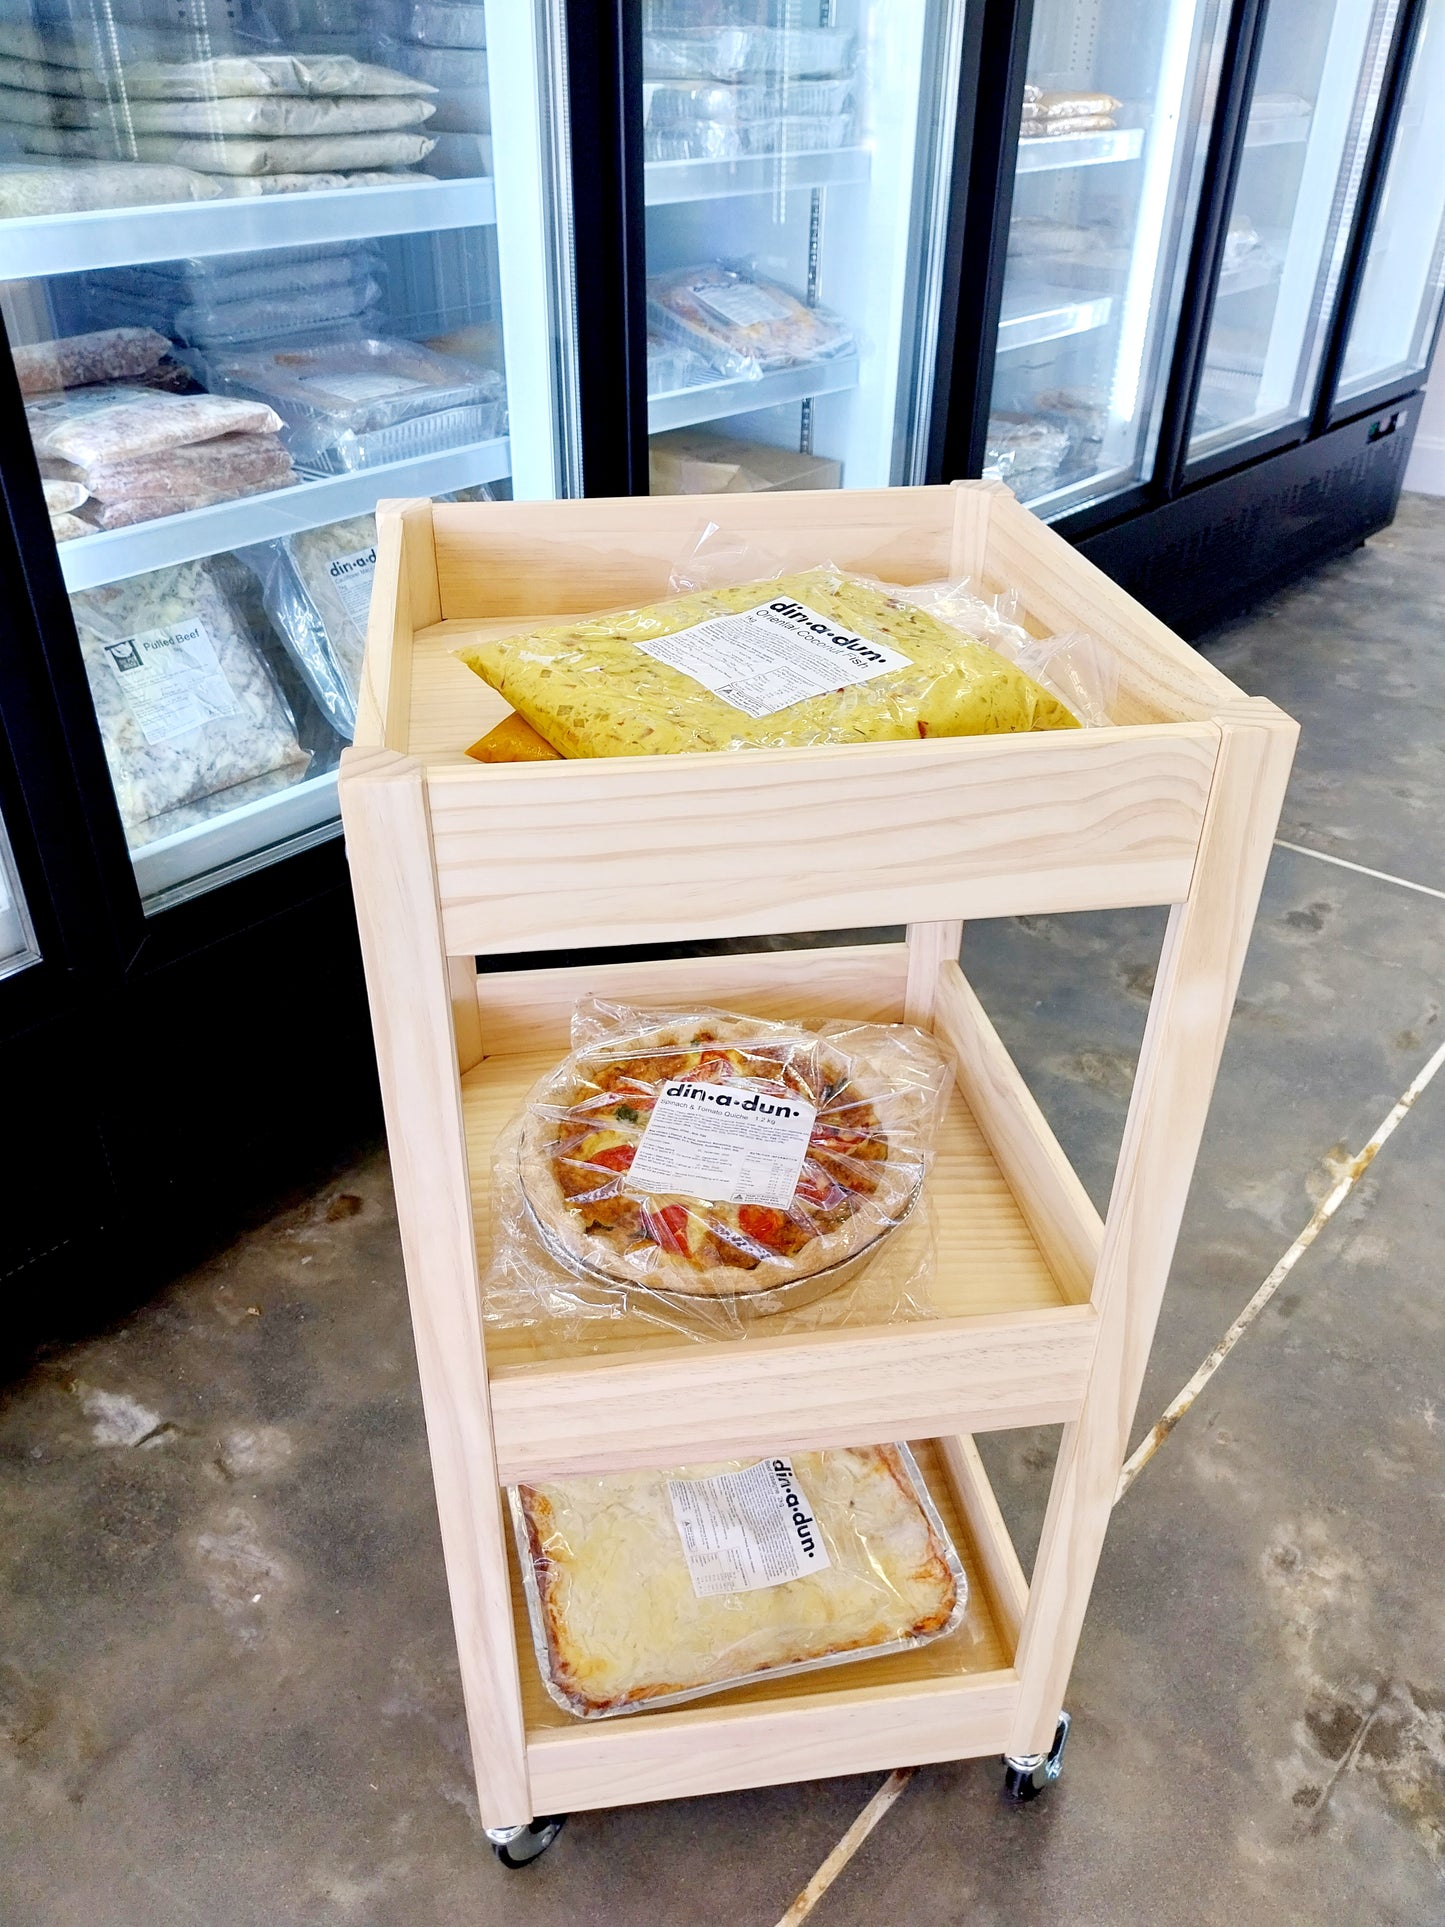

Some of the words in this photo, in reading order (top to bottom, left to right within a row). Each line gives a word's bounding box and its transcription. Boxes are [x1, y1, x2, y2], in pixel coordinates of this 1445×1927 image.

[143, 637, 175, 651] Pulled
[175, 628, 200, 643] Beef
[756, 609, 799, 631] Oriental
[797, 630, 844, 655] Coconut
[843, 651, 870, 669] Fish
[660, 1099, 688, 1110] Spinach
[697, 1106, 723, 1116] Tomato
[724, 1110, 749, 1121] Quiche
